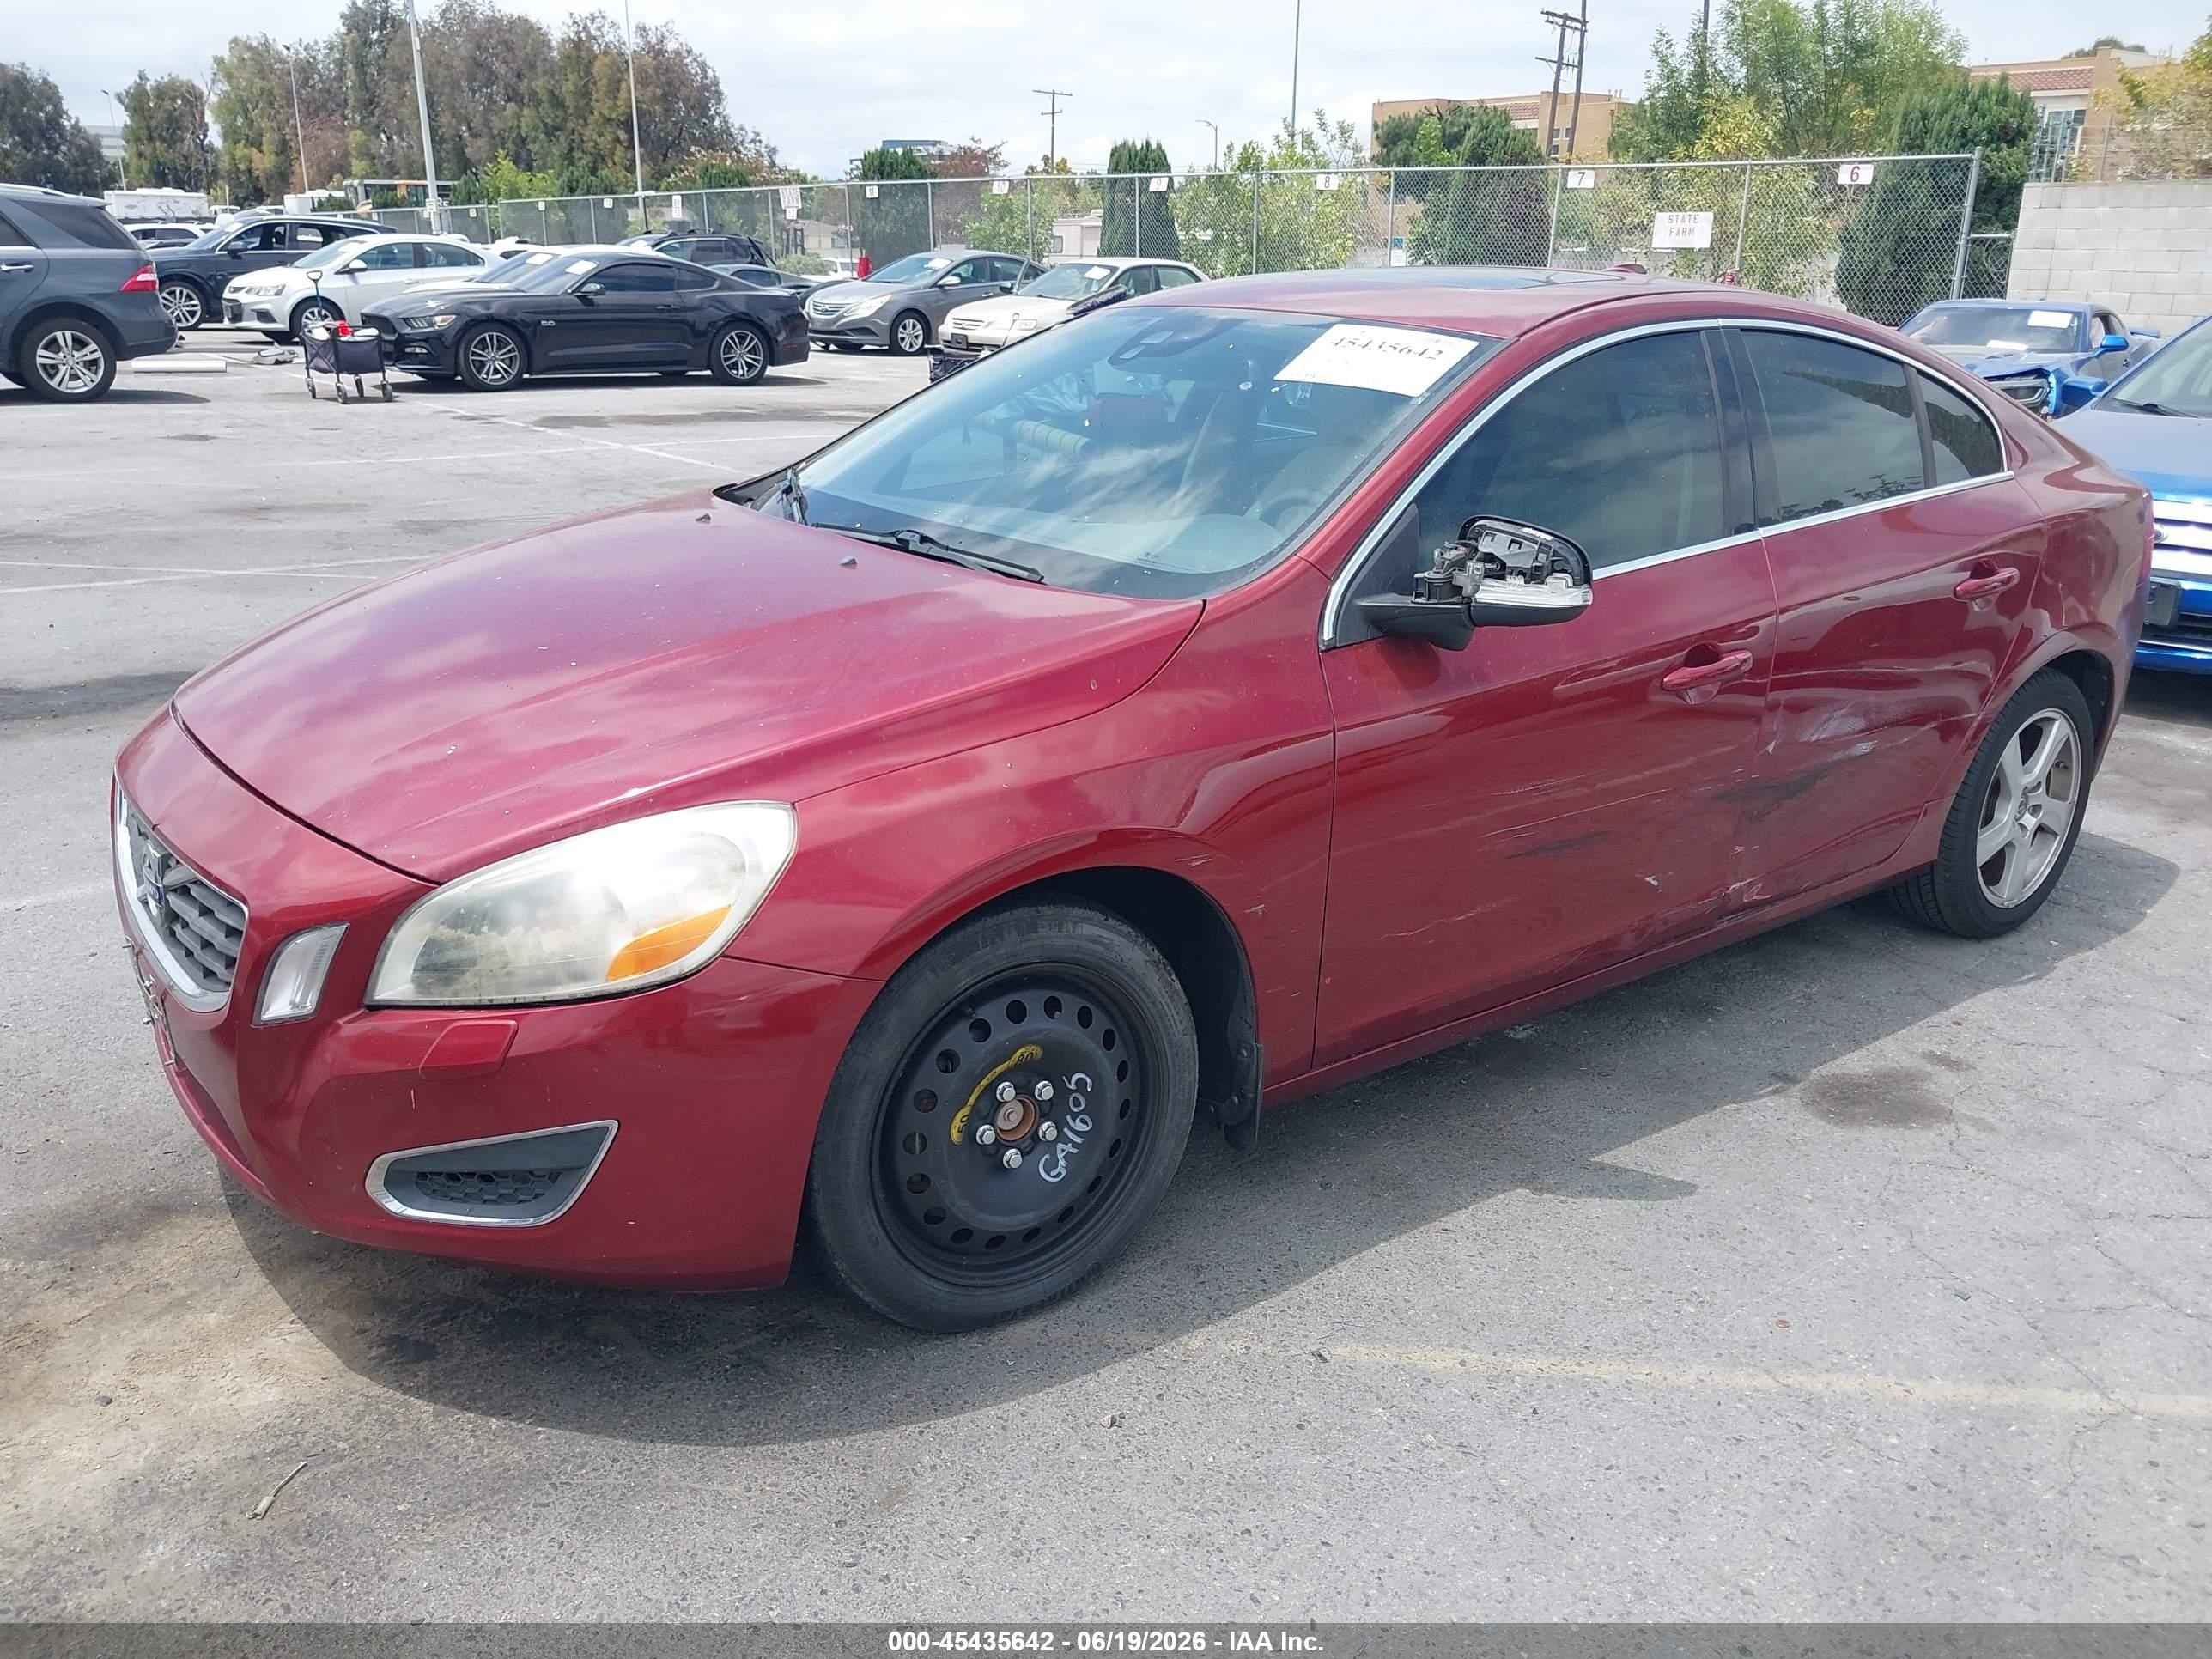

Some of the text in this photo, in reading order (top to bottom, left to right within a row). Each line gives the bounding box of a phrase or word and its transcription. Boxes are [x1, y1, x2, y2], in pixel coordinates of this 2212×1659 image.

[1577, 171, 1586, 186] 7
[1850, 166, 1861, 183] 6
[1156, 179, 1162, 190] 9
[1324, 175, 1331, 188] 8
[1668, 214, 1699, 224] STATE
[1668, 227, 1696, 237] FARM
[1038, 1073, 1093, 1182] GA1605
